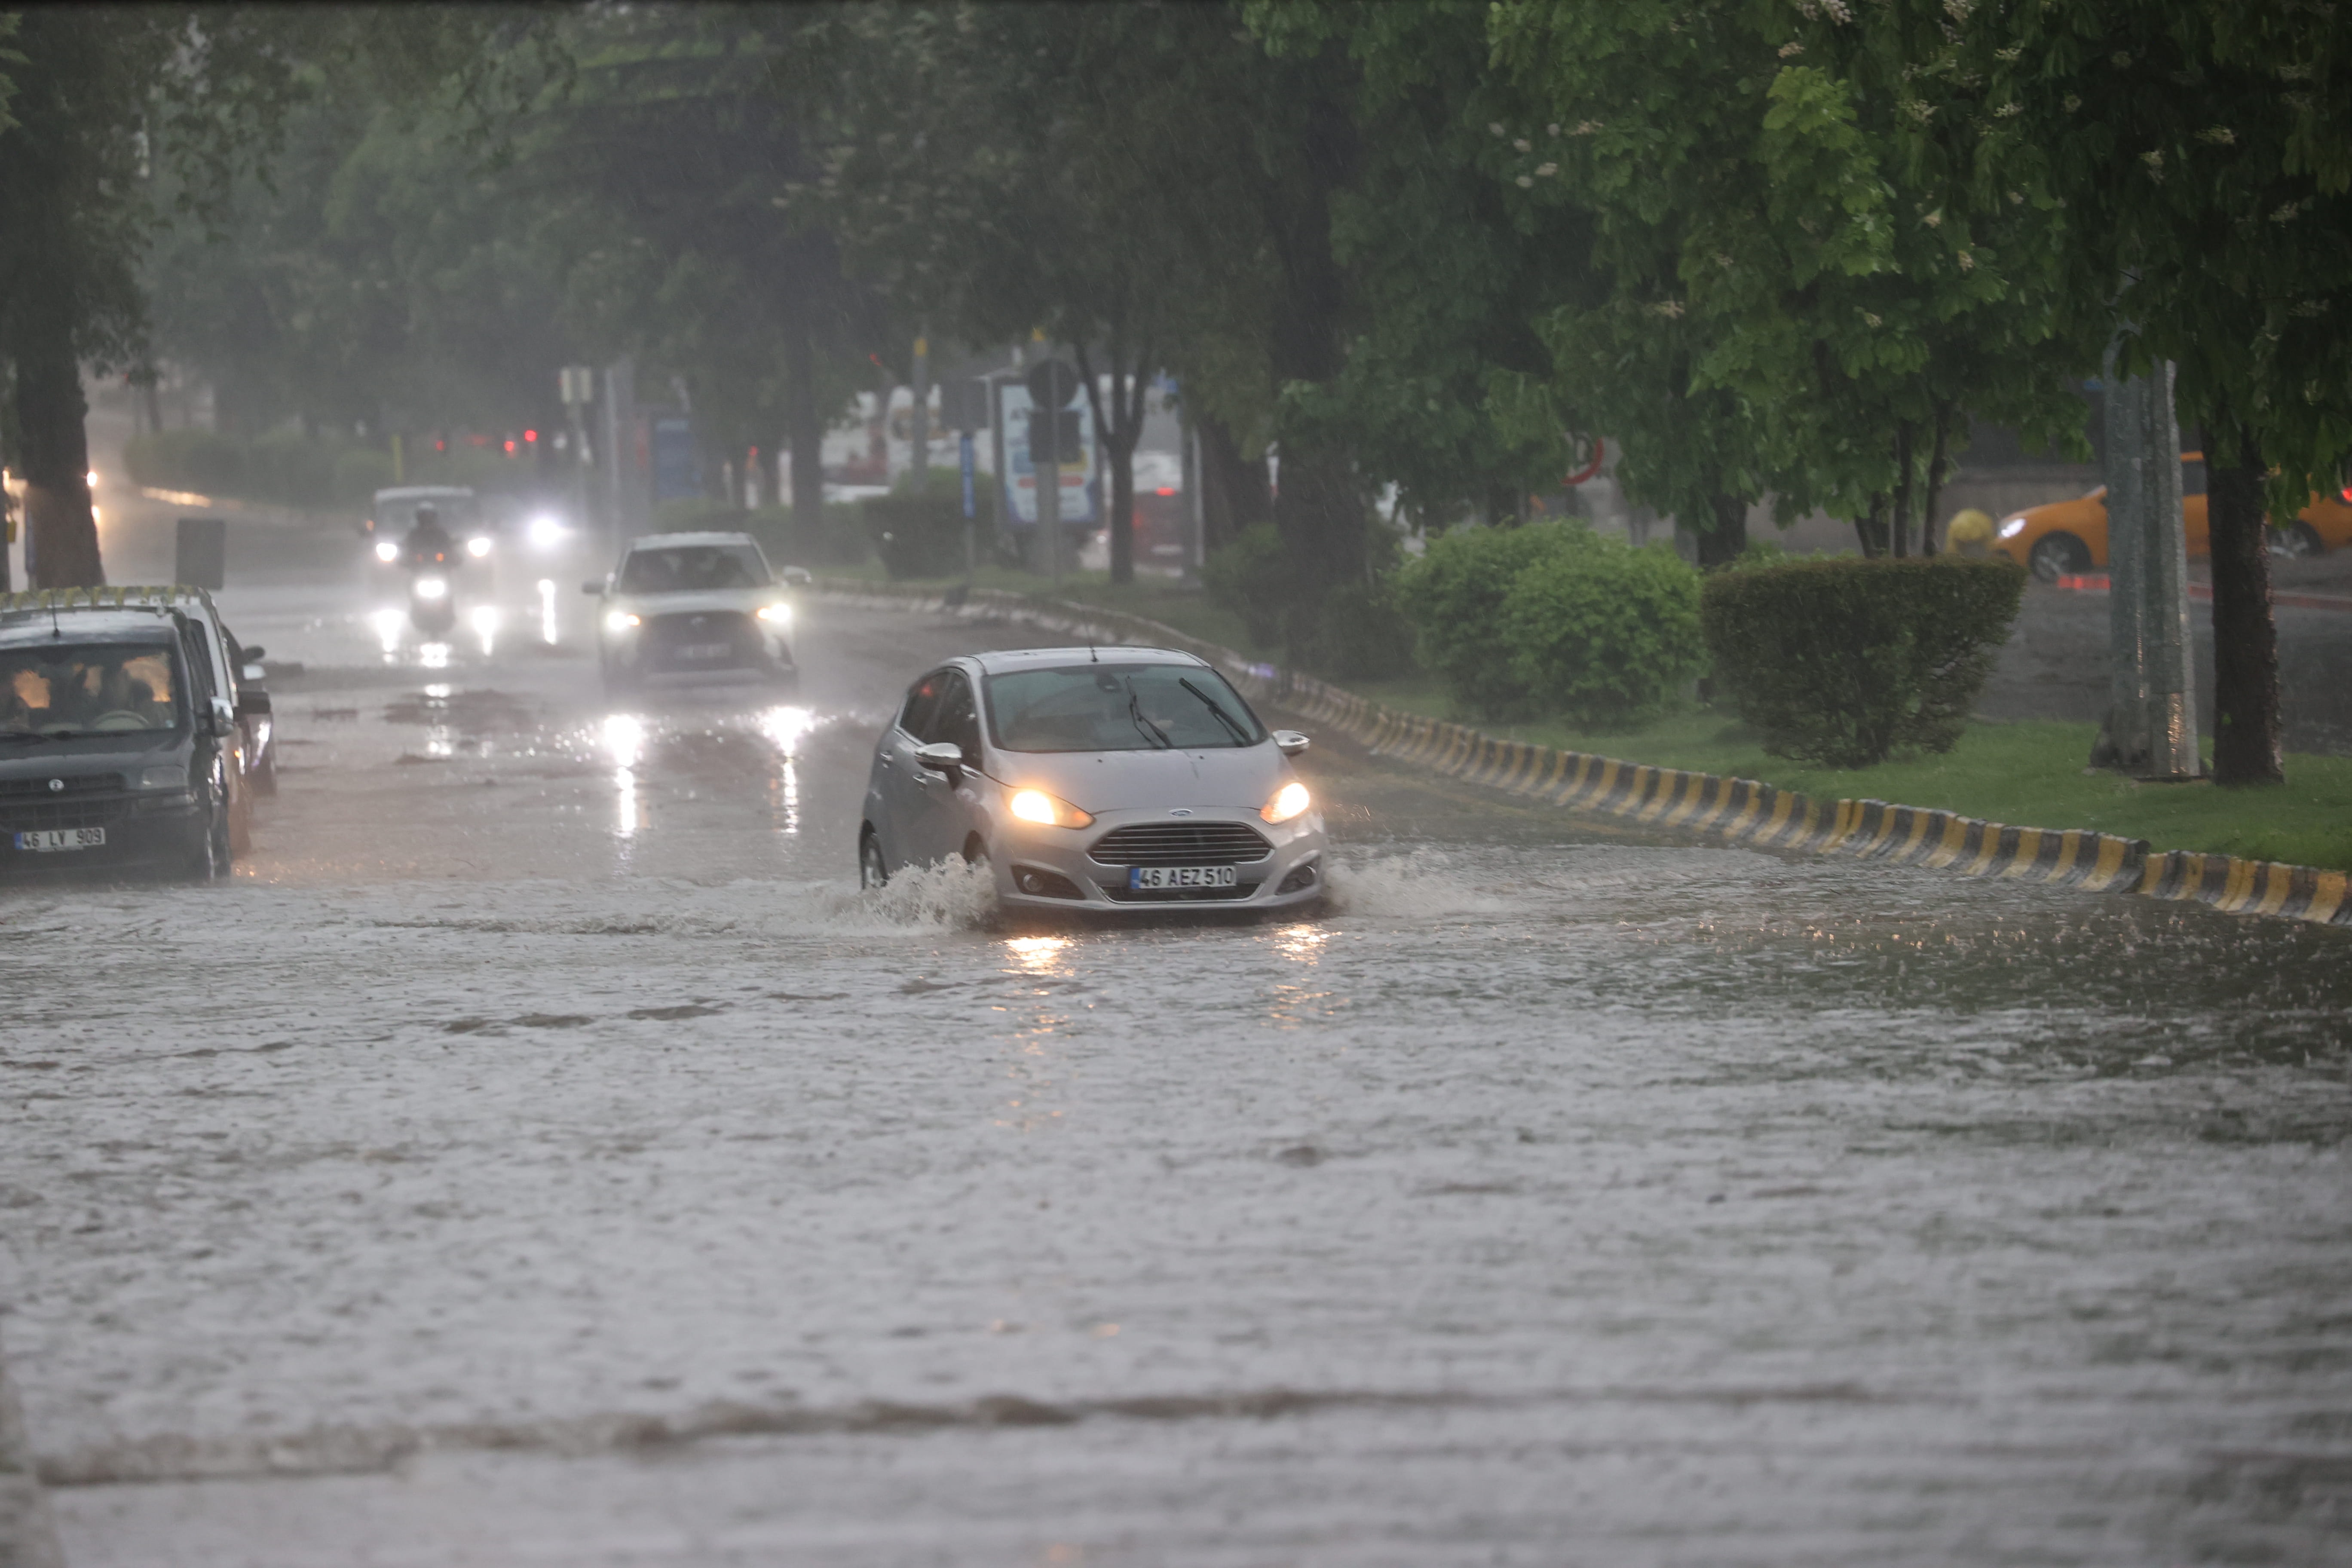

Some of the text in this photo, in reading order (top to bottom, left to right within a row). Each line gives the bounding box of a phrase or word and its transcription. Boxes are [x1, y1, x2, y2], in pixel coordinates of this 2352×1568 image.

[23, 832, 40, 847] 46
[1140, 867, 1233, 887] 46 AEZ 510
